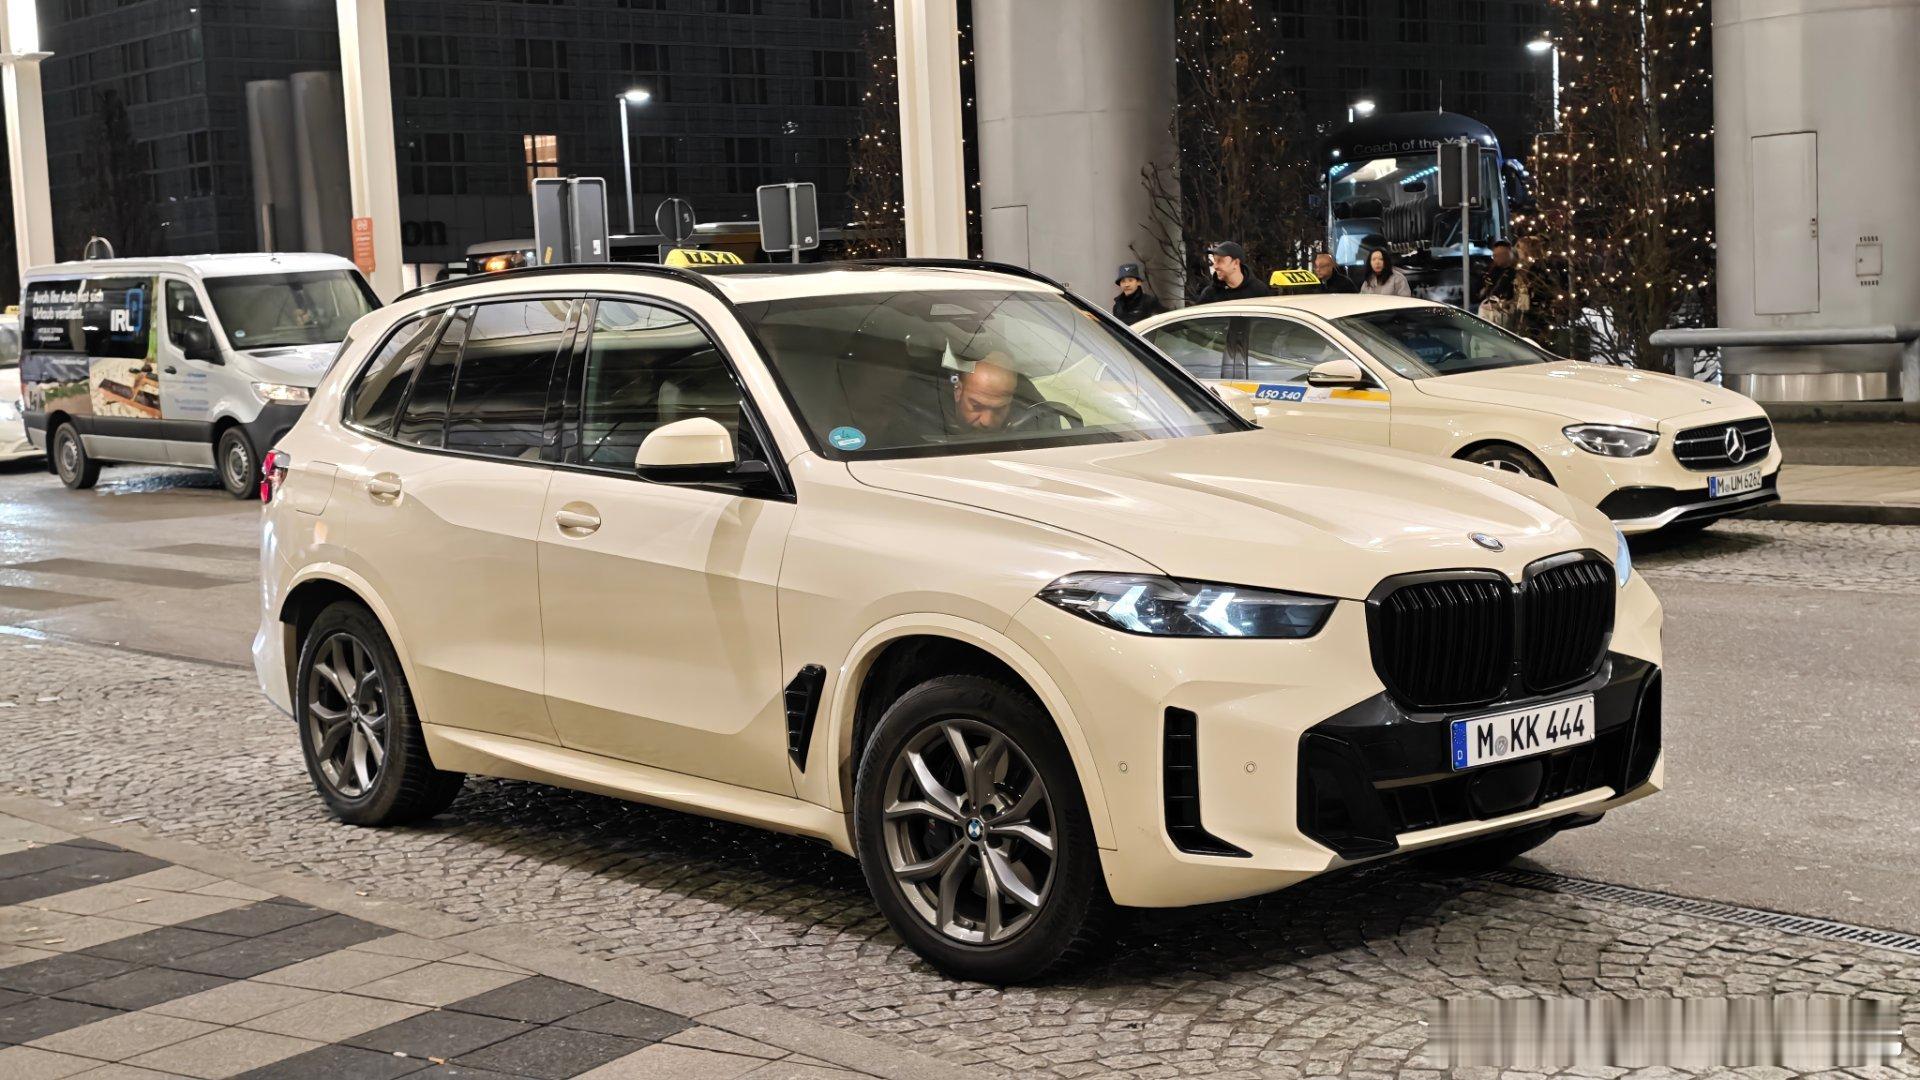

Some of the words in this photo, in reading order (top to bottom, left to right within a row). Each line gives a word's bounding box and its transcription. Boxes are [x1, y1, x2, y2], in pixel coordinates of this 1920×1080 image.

[1353, 142, 1398, 154] Coach
[1402, 139, 1417, 151] of
[1419, 139, 1440, 149] the
[682, 250, 743, 264] TAXI
[111, 309, 134, 331] IRL
[1258, 389, 1278, 399] 450
[1280, 390, 1300, 400] 540
[1717, 478, 1724, 493] M
[1730, 474, 1743, 490] UM
[1477, 723, 1493, 758] M
[1511, 714, 1539, 752] KK
[1545, 704, 1584, 743] 444
[1457, 750, 1463, 760] D
